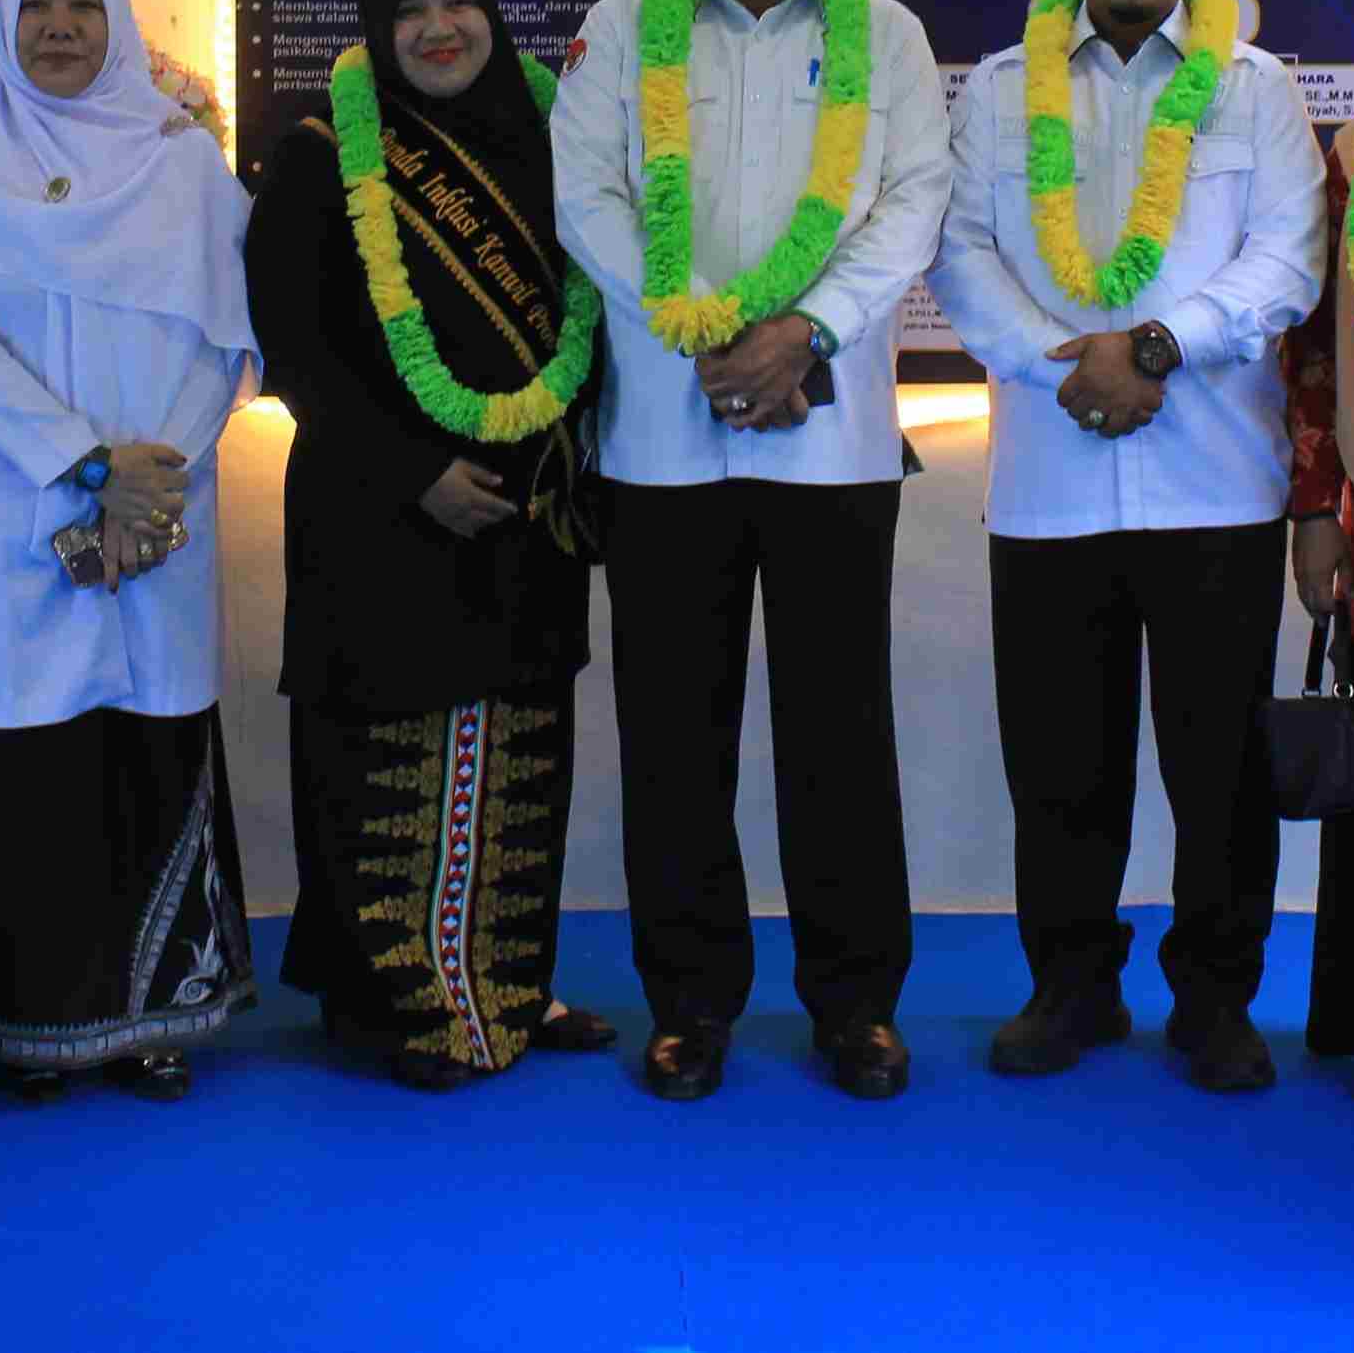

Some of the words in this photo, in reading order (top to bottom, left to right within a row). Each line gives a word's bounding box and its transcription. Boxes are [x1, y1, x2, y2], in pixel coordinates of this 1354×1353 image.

[273, 0, 358, 12] Memberikan
[272, 12, 312, 23] siswa
[316, 12, 359, 23] dalam
